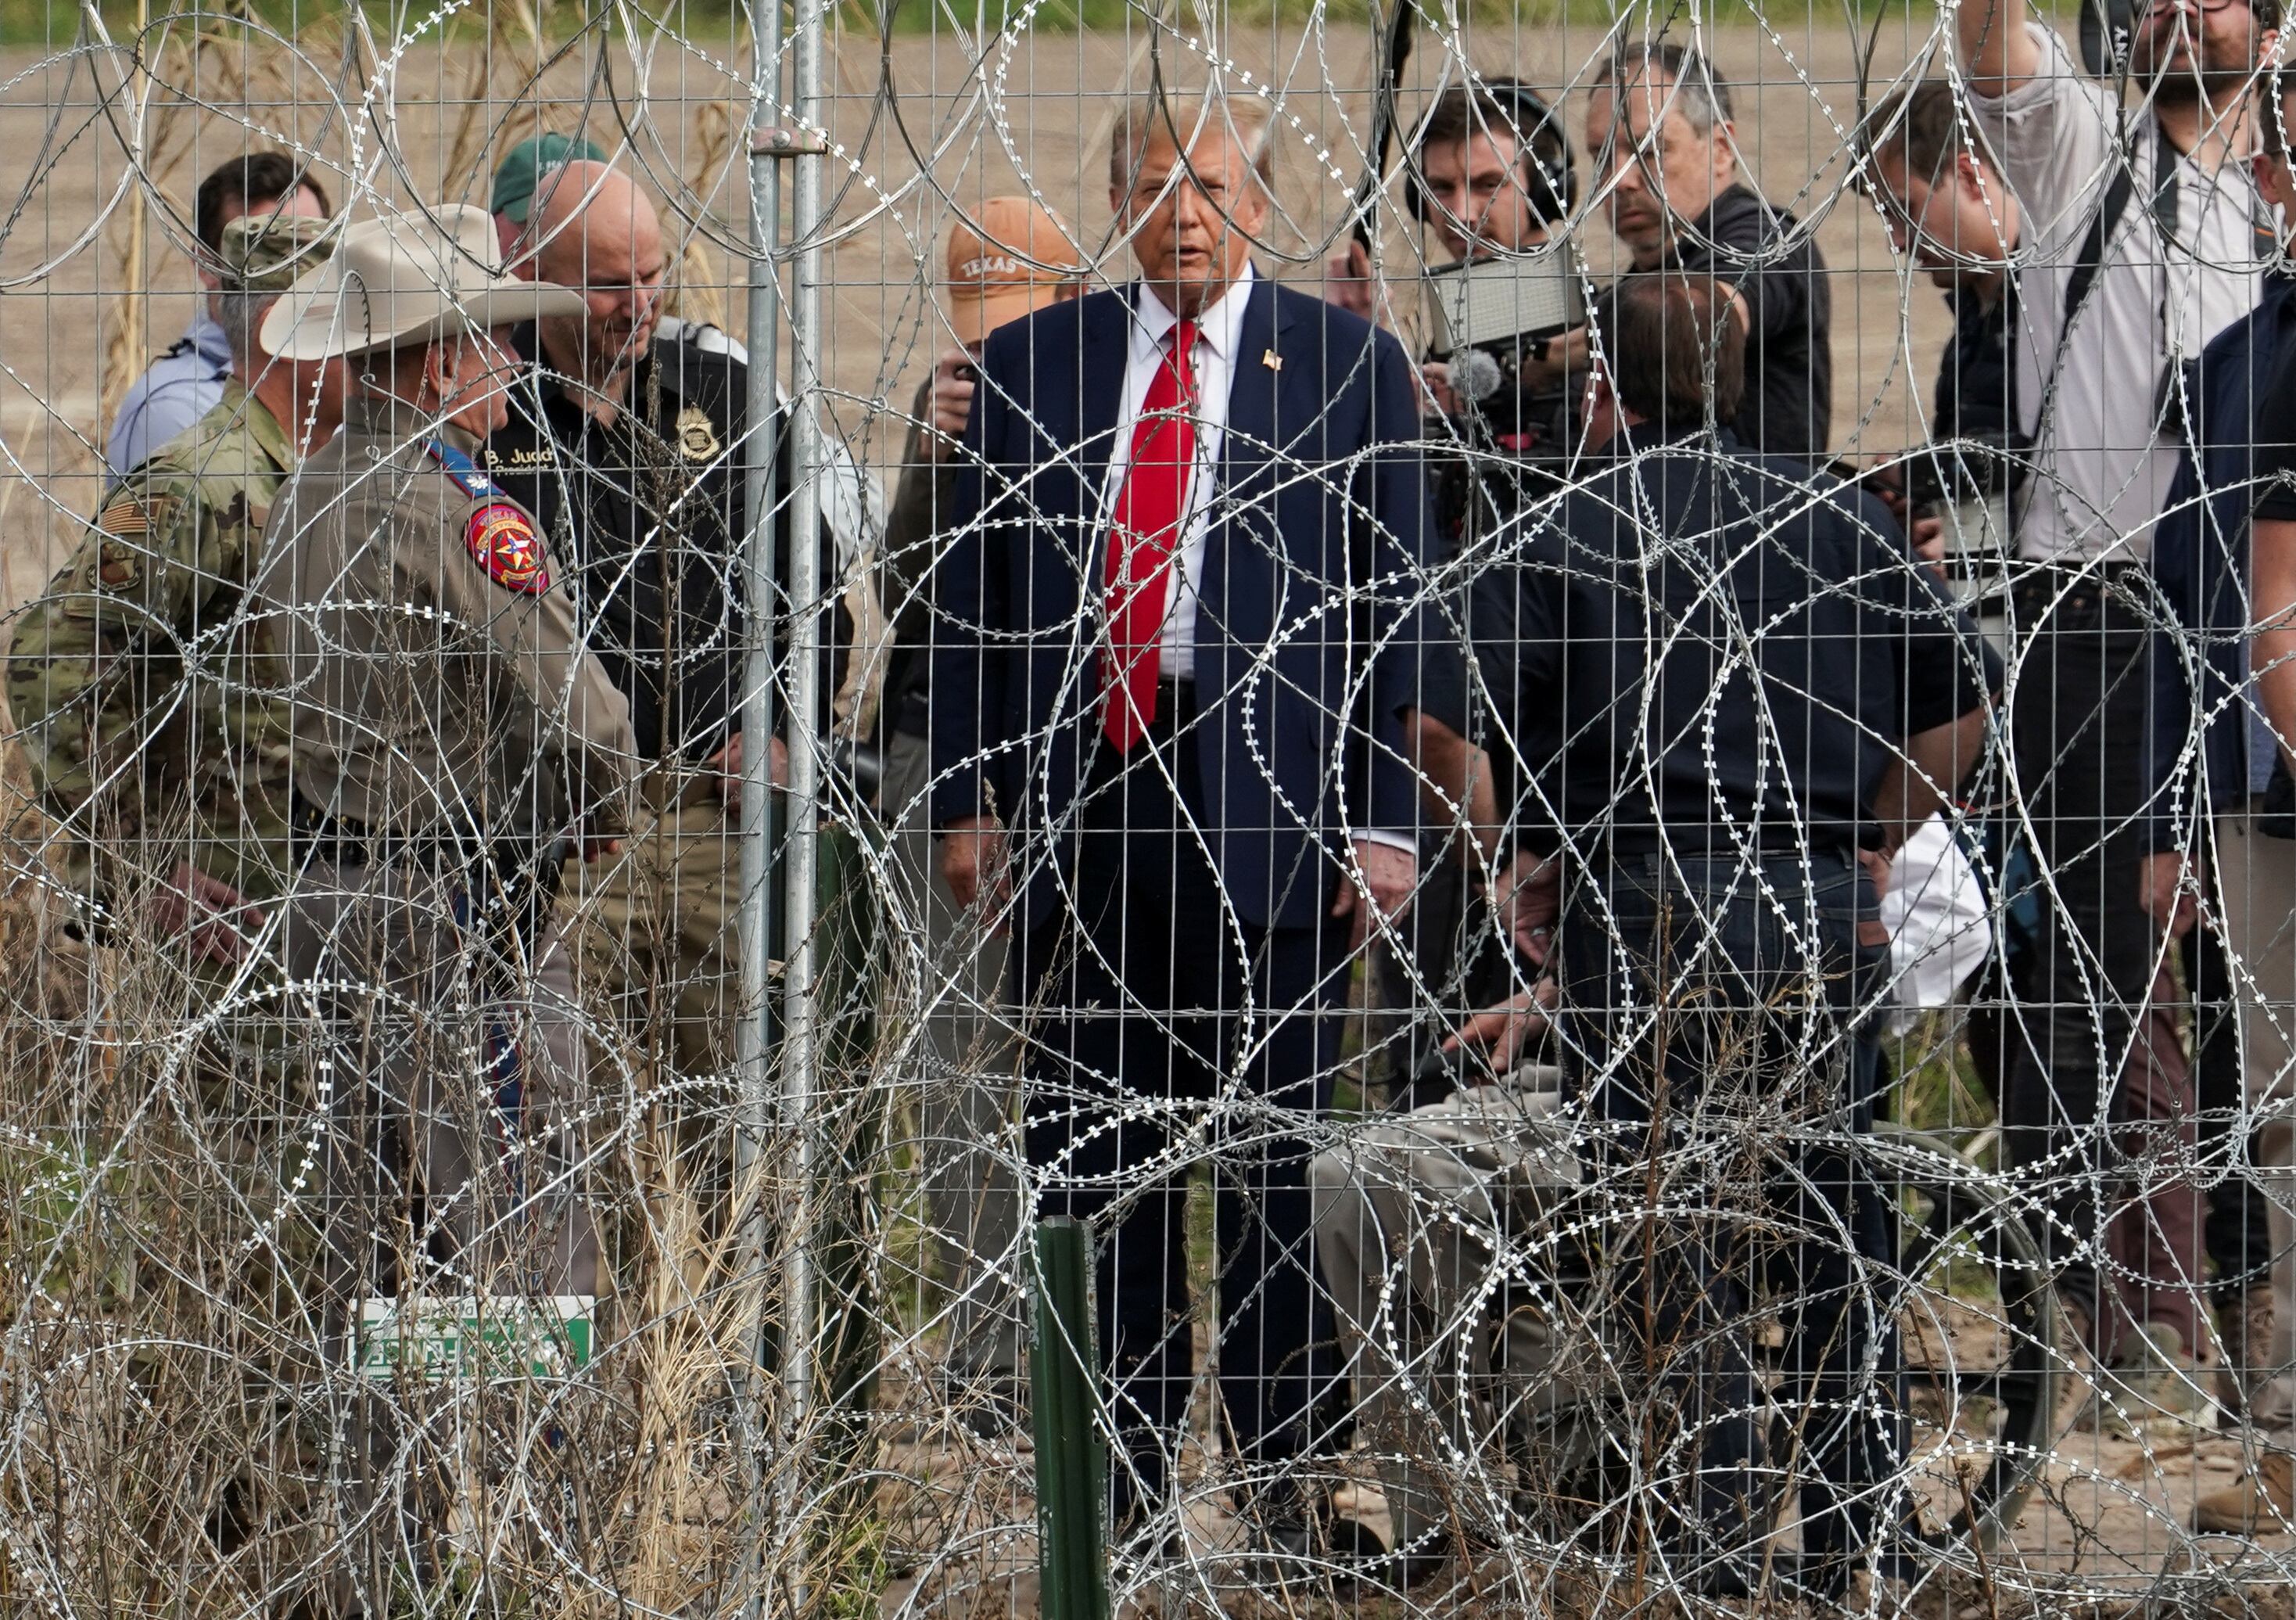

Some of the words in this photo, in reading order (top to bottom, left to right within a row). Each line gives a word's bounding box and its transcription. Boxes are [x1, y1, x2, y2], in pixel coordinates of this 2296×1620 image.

[960, 256, 1017, 277] TEXAS
[484, 450, 503, 465] B.
[511, 447, 554, 463] Judd
